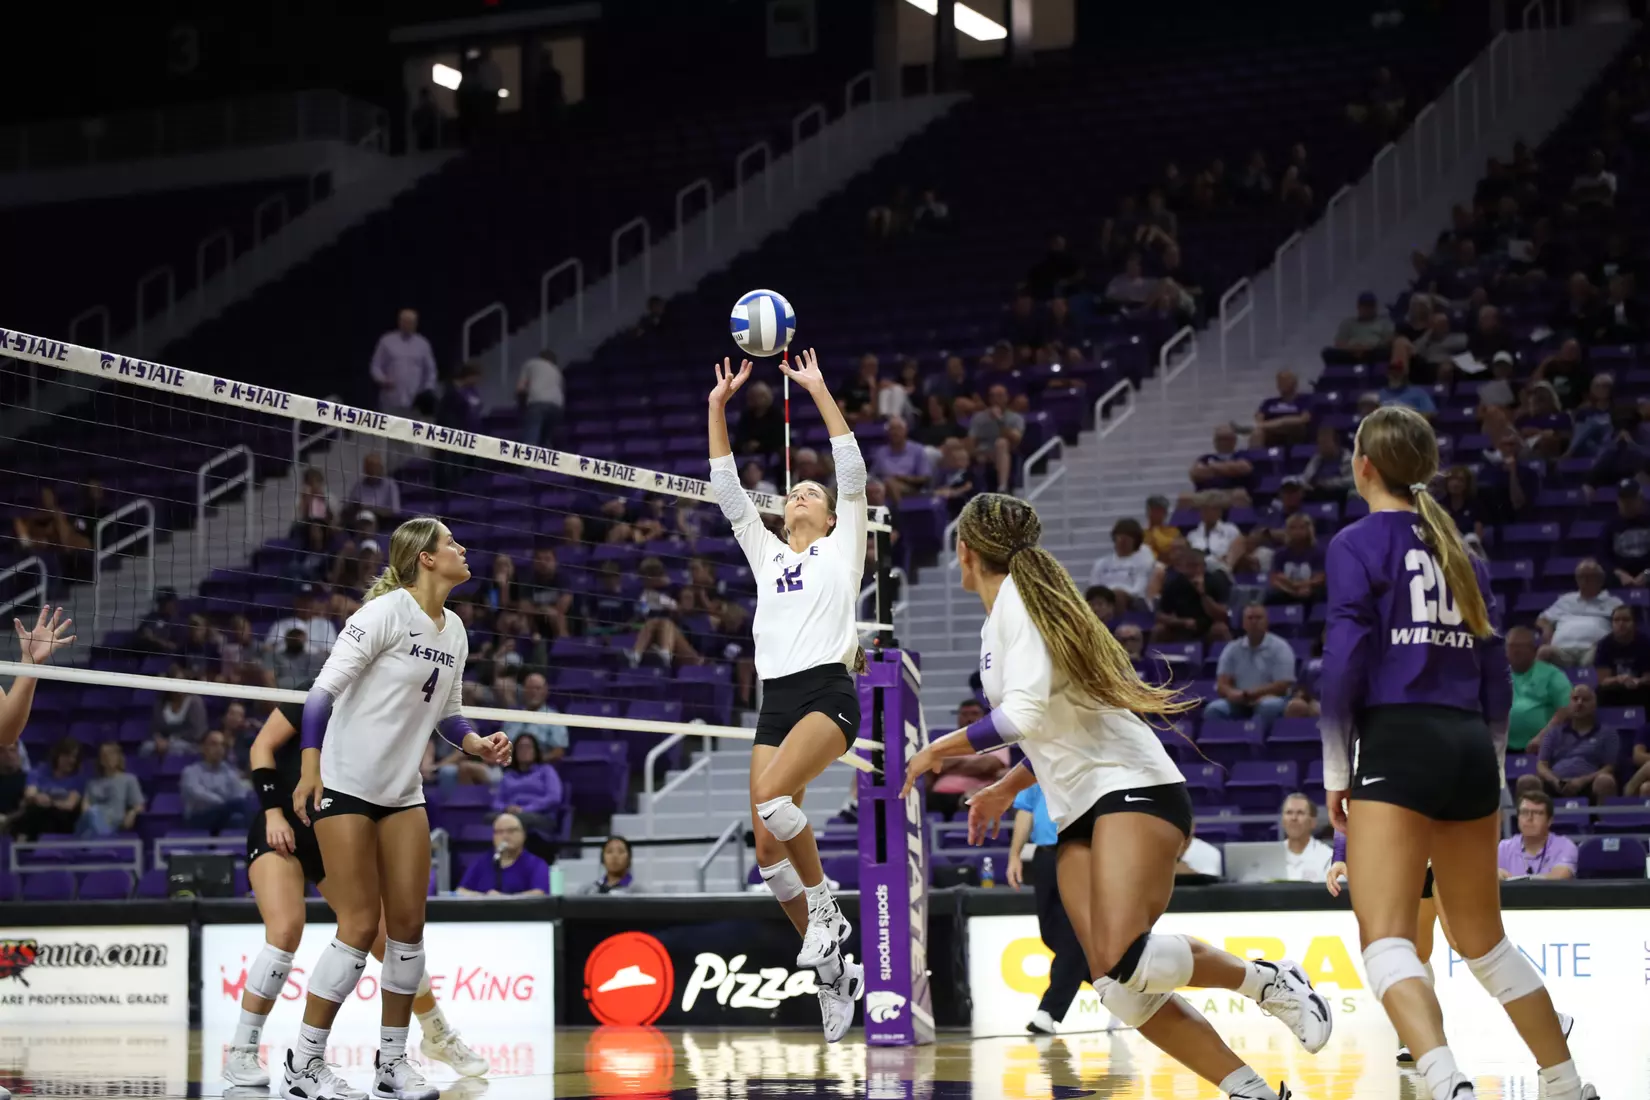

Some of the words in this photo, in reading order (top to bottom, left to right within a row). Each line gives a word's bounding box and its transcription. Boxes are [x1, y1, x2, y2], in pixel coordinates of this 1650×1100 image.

[0, 329, 70, 362] K-STATE
[119, 357, 186, 388] K-STATE
[230, 382, 292, 411] K-STATE
[333, 405, 389, 431] K-STATE
[425, 424, 478, 450] K-STATE
[512, 444, 561, 467] K-STATE
[593, 460, 637, 483] K-STATE
[666, 477, 708, 497] K-STATE
[409, 643, 455, 668] K-STATE
[1391, 626, 1475, 649] WILCATS
[421, 667, 440, 703] 4
[875, 884, 890, 927] sports
[877, 928, 893, 981] imports
[28, 994, 122, 1006] PROFESSIONAL
[127, 994, 169, 1006] GRADE
[681, 952, 820, 1012] Pizza
